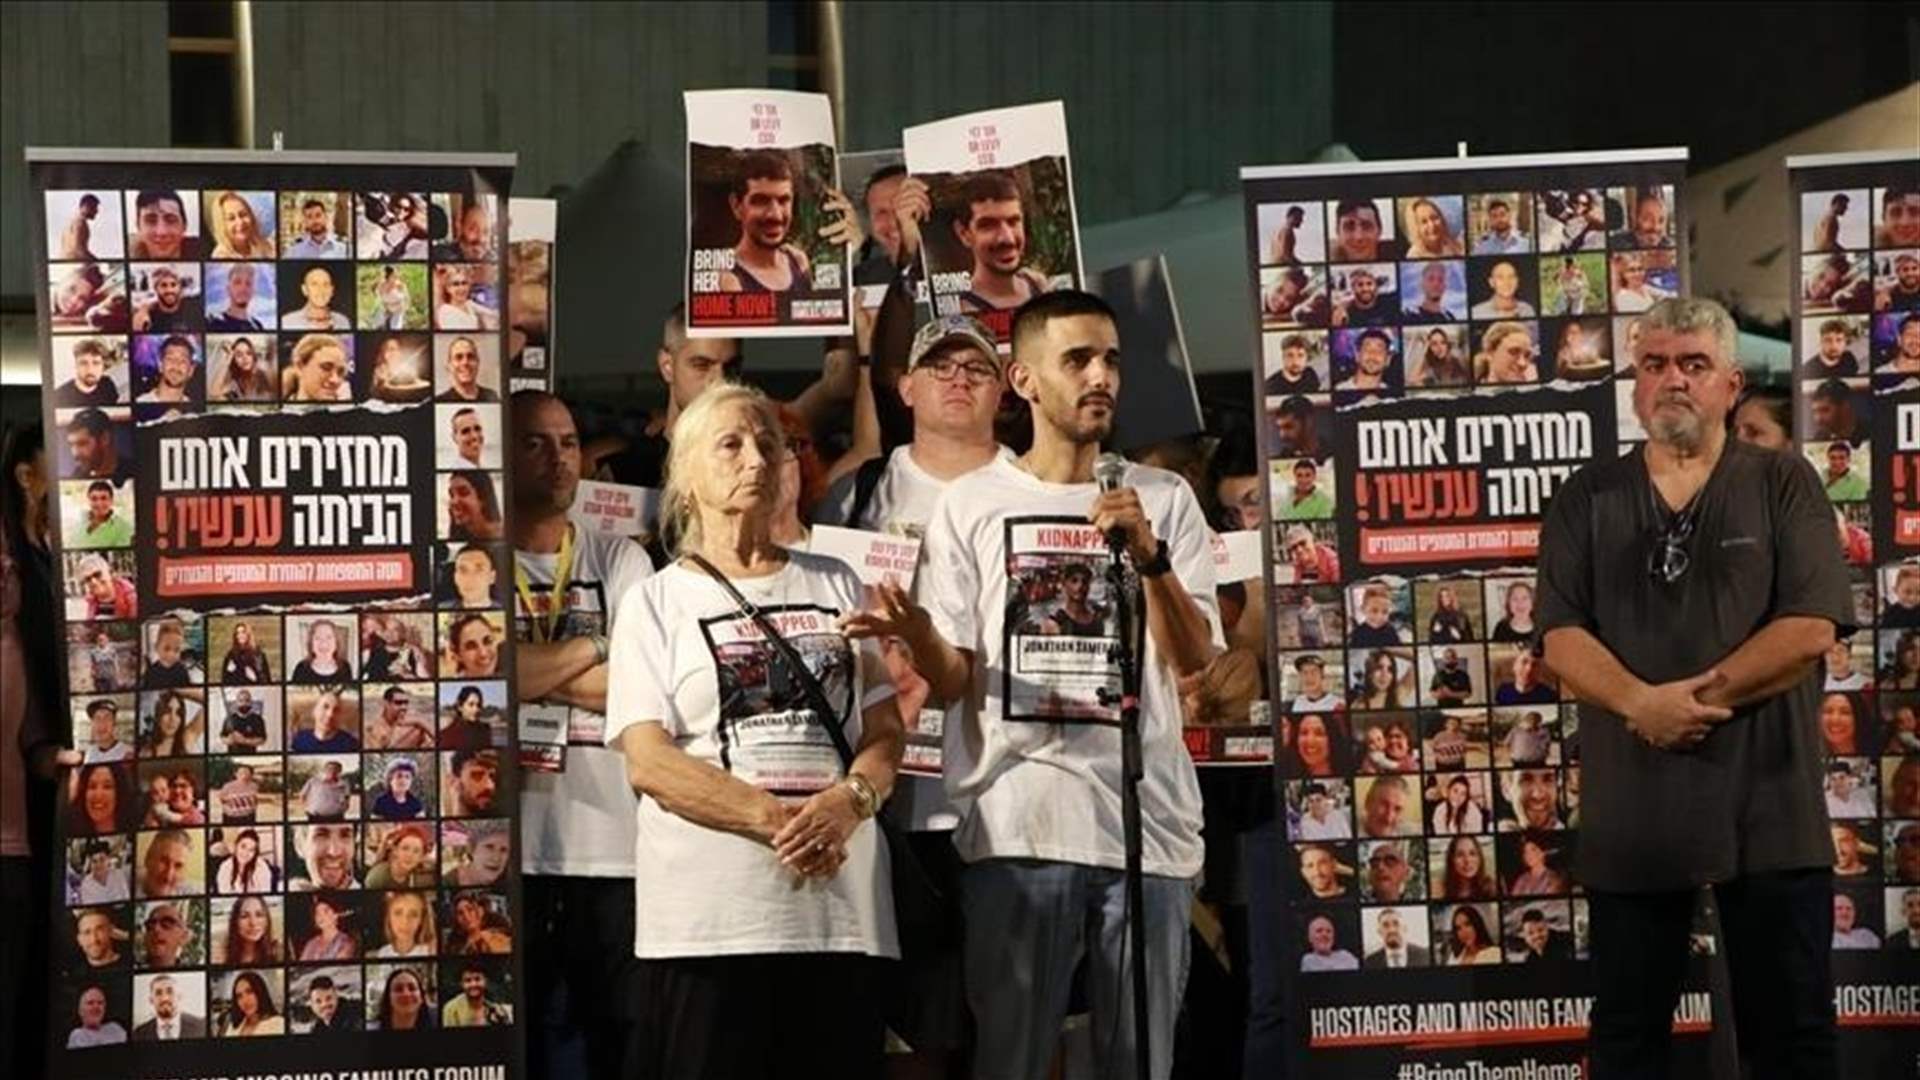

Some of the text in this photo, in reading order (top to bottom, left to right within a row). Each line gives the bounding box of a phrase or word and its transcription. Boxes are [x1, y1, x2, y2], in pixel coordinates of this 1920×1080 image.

[694, 249, 735, 270] BRING
[693, 271, 721, 292] HER
[932, 271, 972, 294] BRING
[1357, 411, 1593, 468] מחזירים אותם
[159, 435, 408, 491] מחזירים אותם
[1355, 464, 1584, 521] יתה עכשיו!
[155, 494, 412, 549] הביתה עכשיו!
[1036, 528, 1110, 549] KIDNAPP
[735, 614, 819, 639] KIDPPED
[1832, 984, 1920, 1017] HOSTAGE
[1311, 1004, 1412, 1038] HOSTAGES
[1416, 1002, 1456, 1034] AND
[1460, 998, 1549, 1032] MISSING
